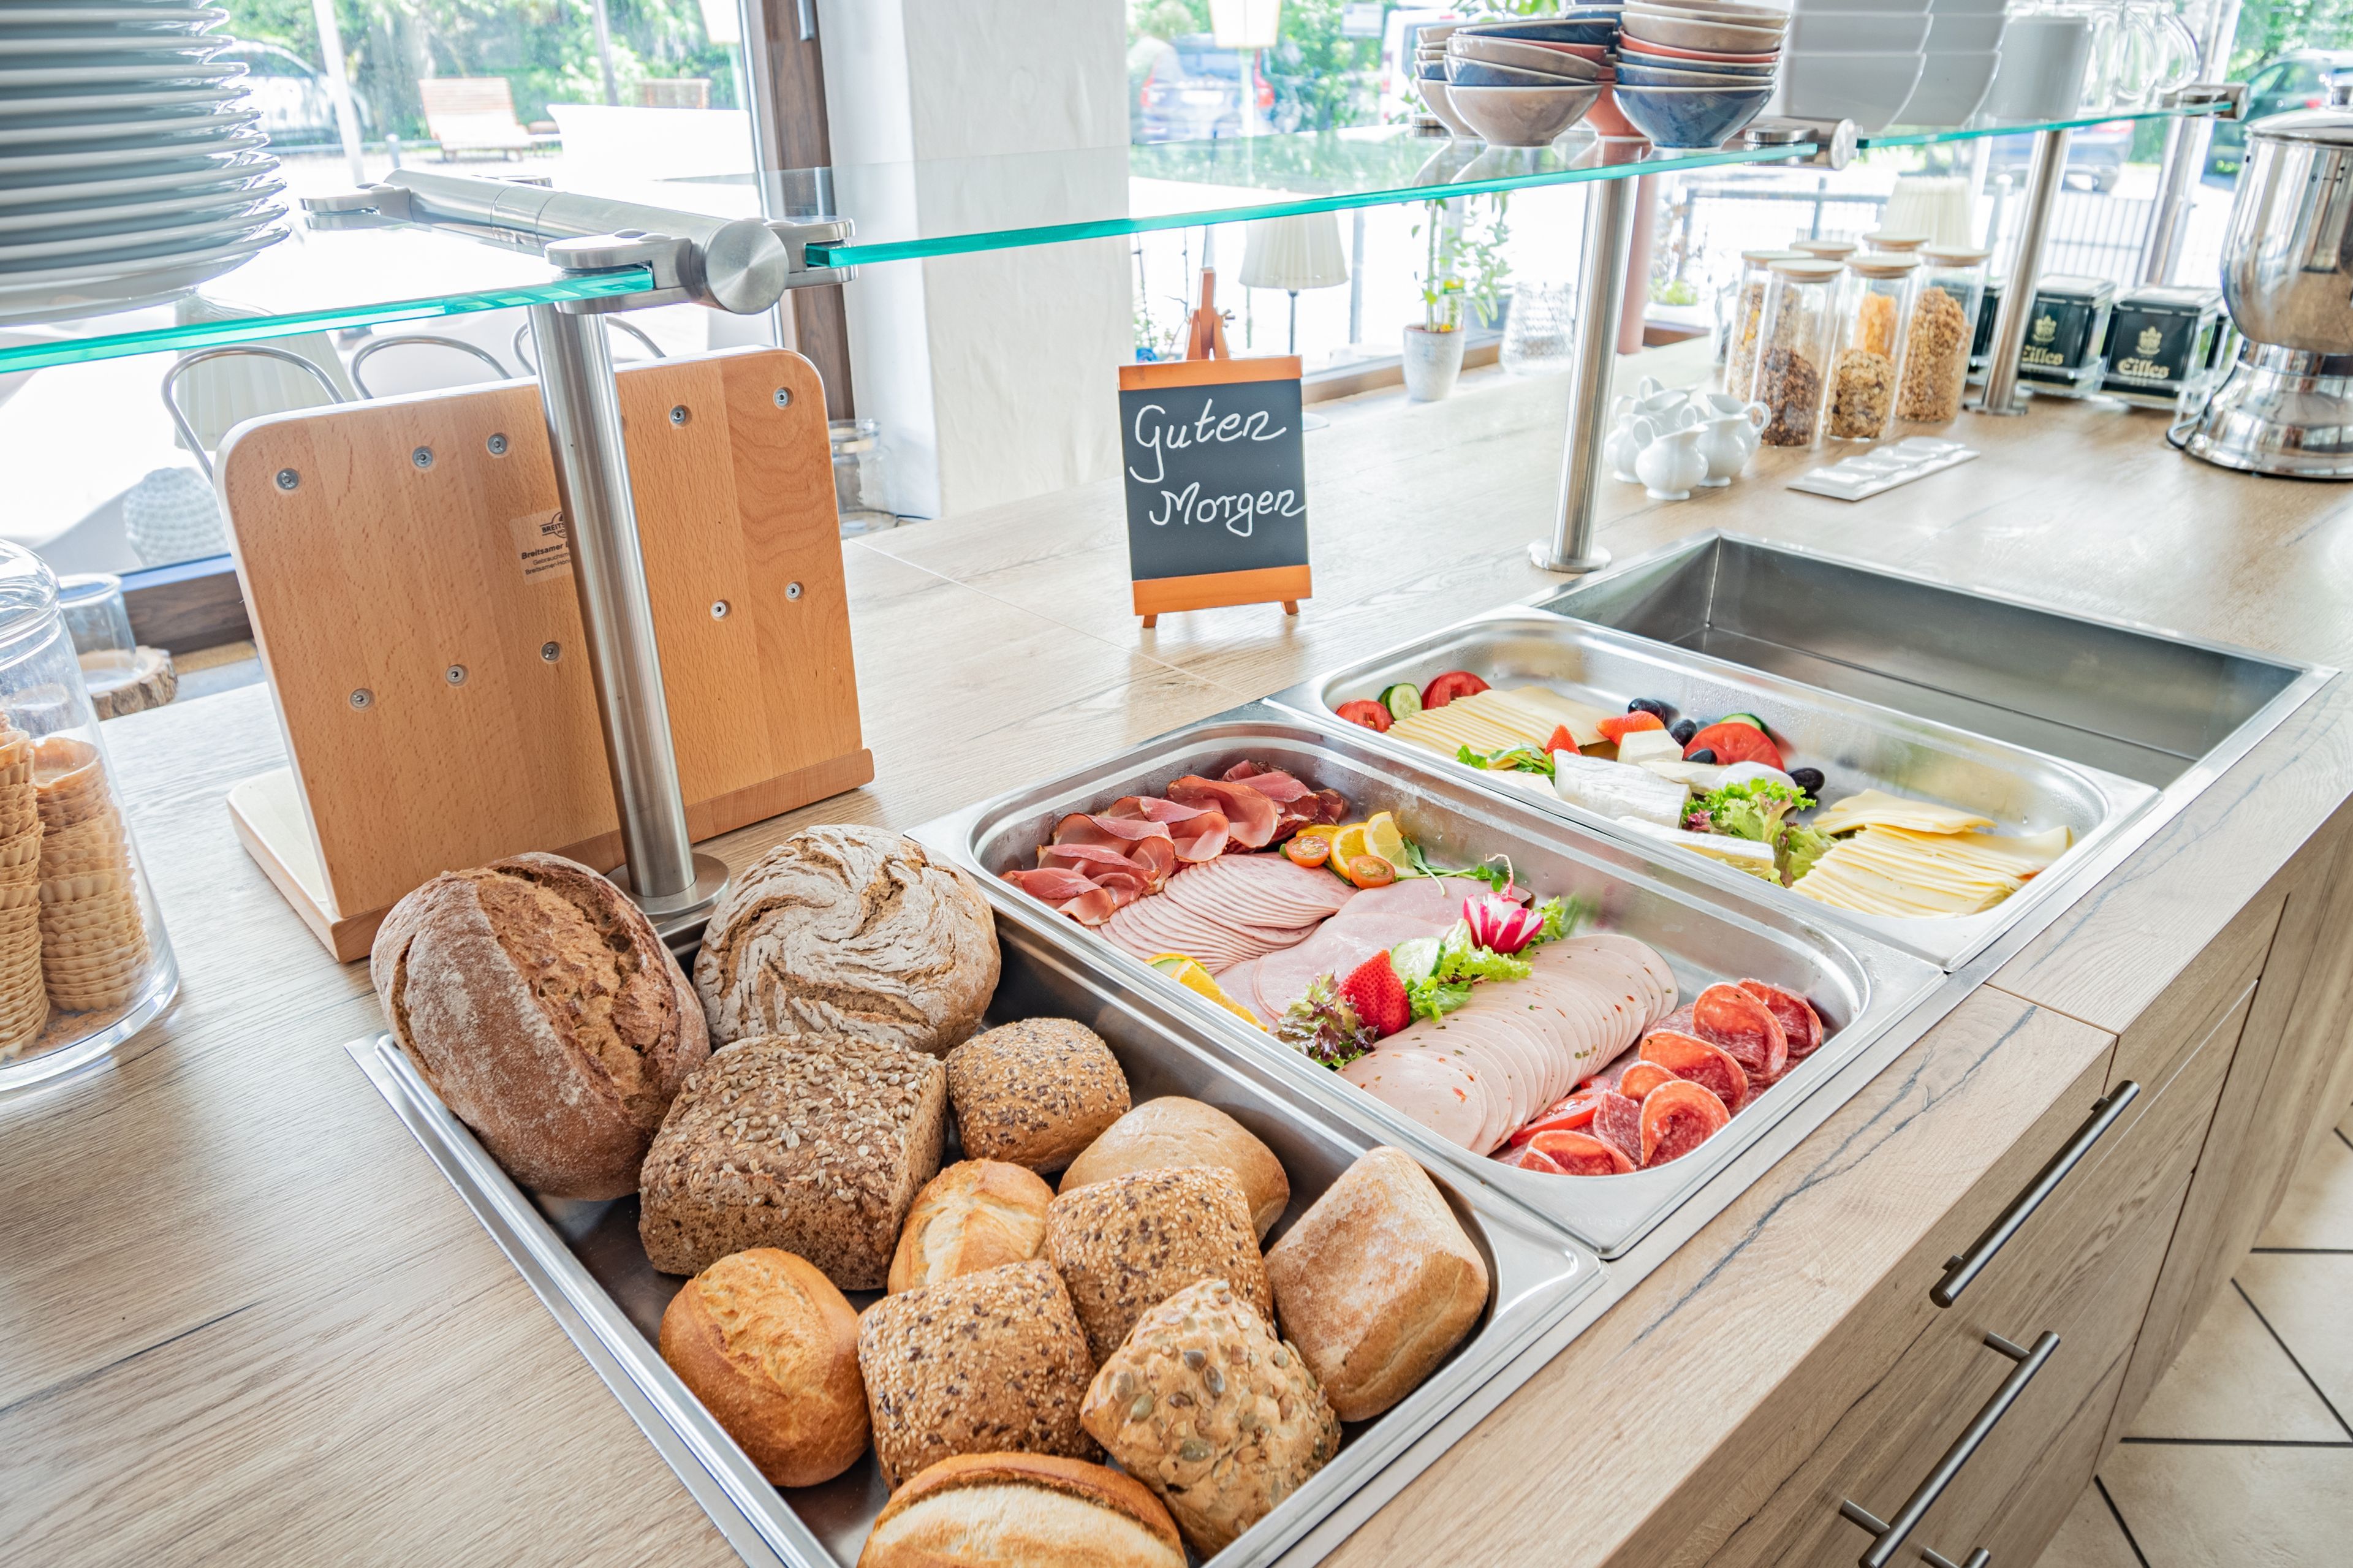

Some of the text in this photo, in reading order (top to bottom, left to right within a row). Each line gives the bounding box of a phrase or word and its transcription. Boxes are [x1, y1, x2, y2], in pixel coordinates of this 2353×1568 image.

[2118, 357, 2170, 379] Eilles
[1129, 398, 1287, 483] Guten
[1149, 482, 1307, 537] Morgen
[542, 522, 565, 534] BREITS
[521, 543, 564, 559] Breitsamer
[525, 559, 571, 575] Breitsamer-Hon
[532, 553, 570, 566] Gebrauchsm
